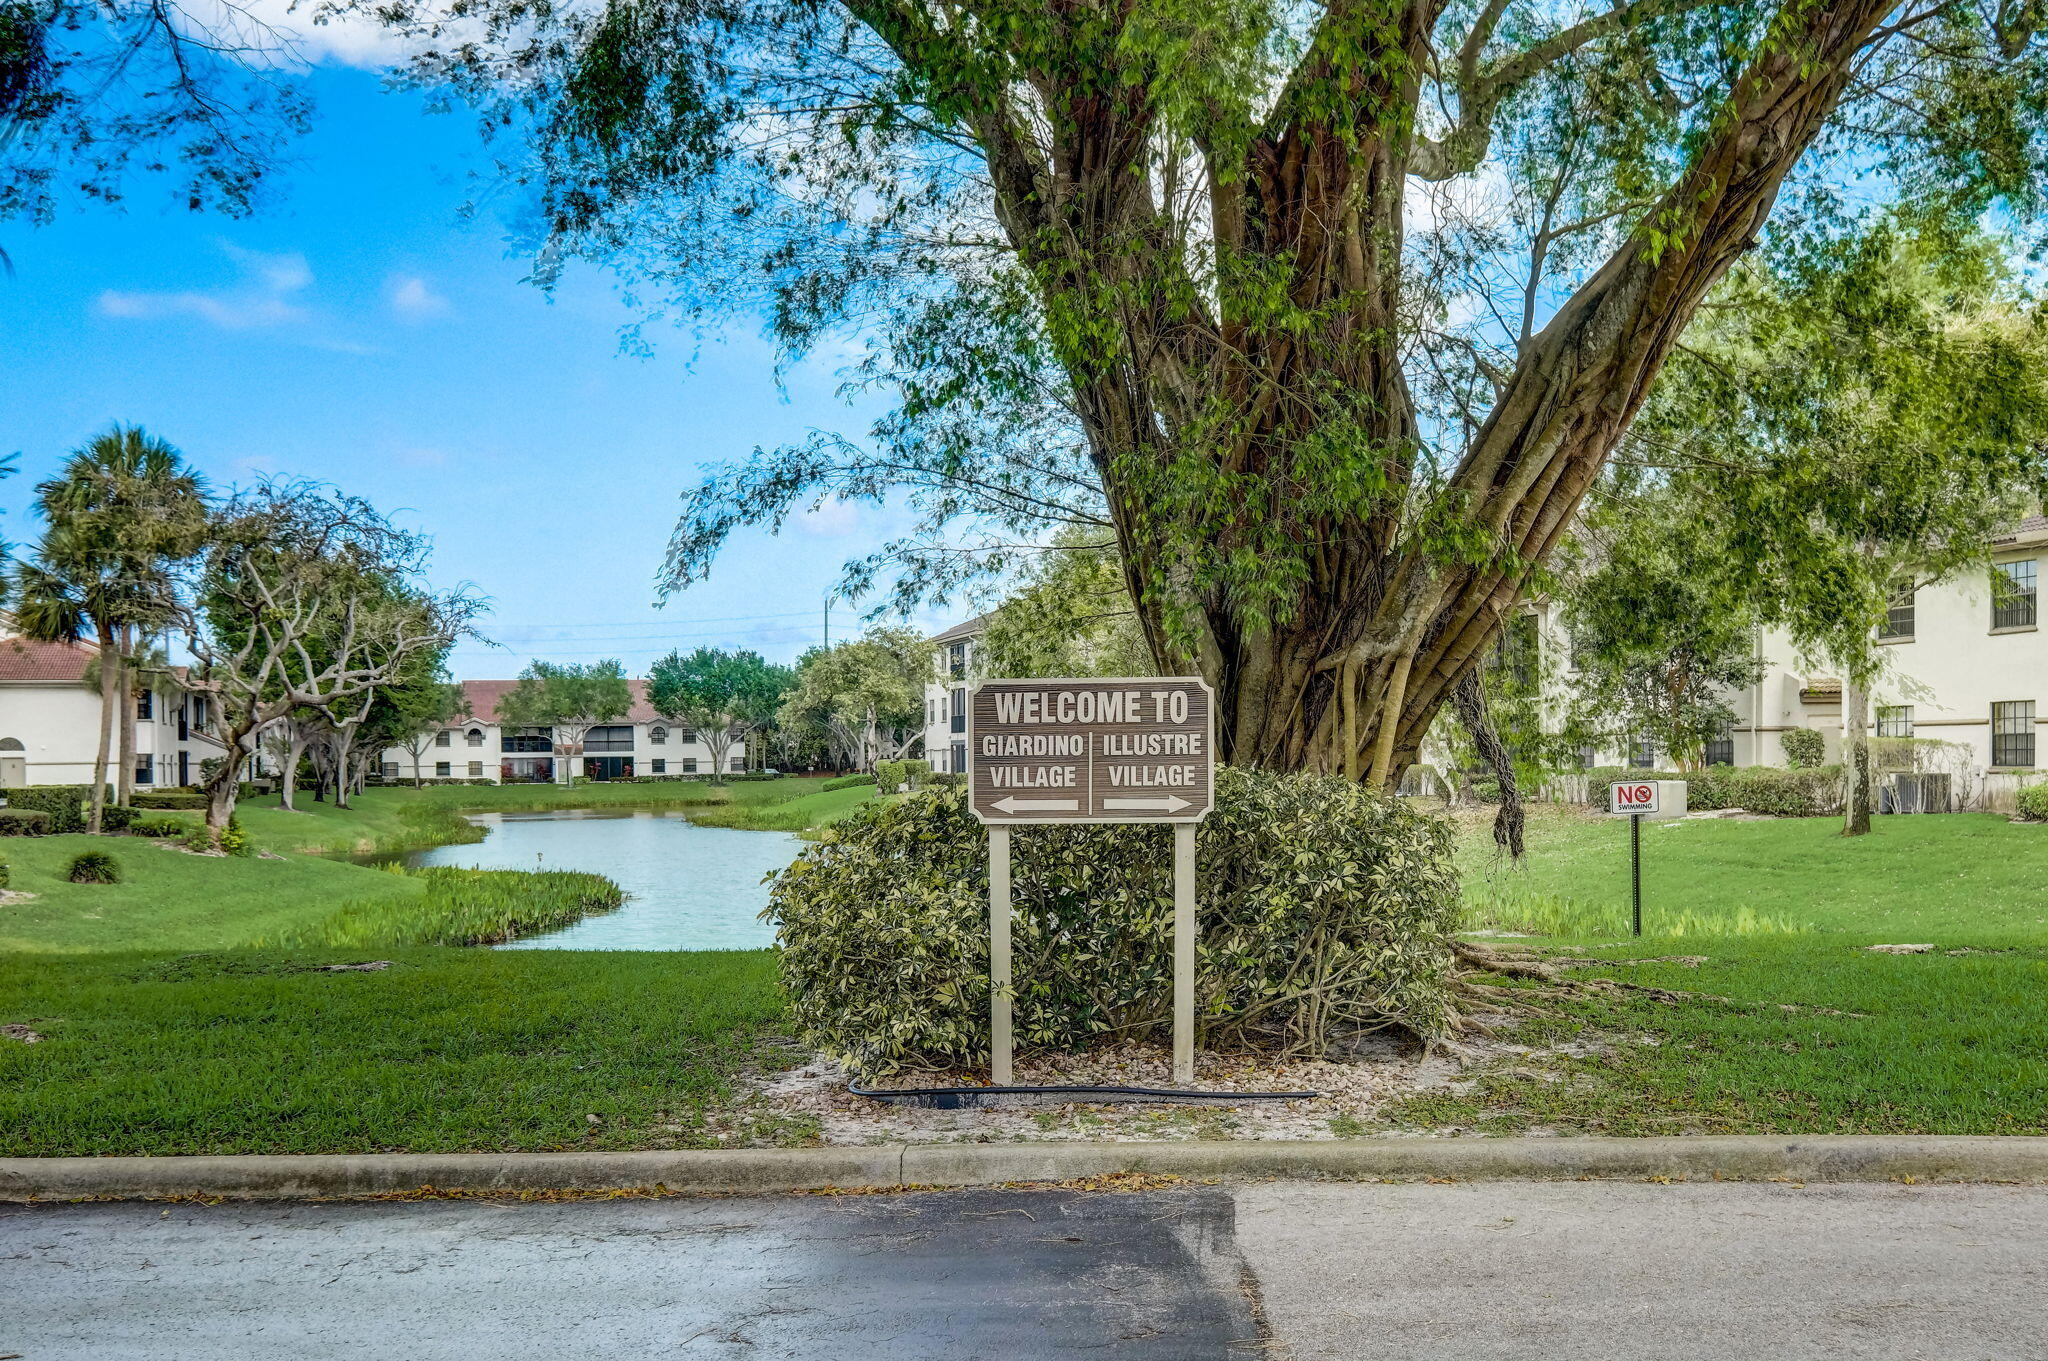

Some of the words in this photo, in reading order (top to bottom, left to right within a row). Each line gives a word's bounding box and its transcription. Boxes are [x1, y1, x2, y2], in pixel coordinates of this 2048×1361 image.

[995, 691, 1141, 724] WELCOME
[1151, 690, 1188, 724] TO
[983, 735, 1083, 756] GIARDINO
[1104, 733, 1201, 755] ILLUSTRE
[990, 766, 1076, 787] VILLAGE
[1109, 765, 1195, 786] VILLAGE
